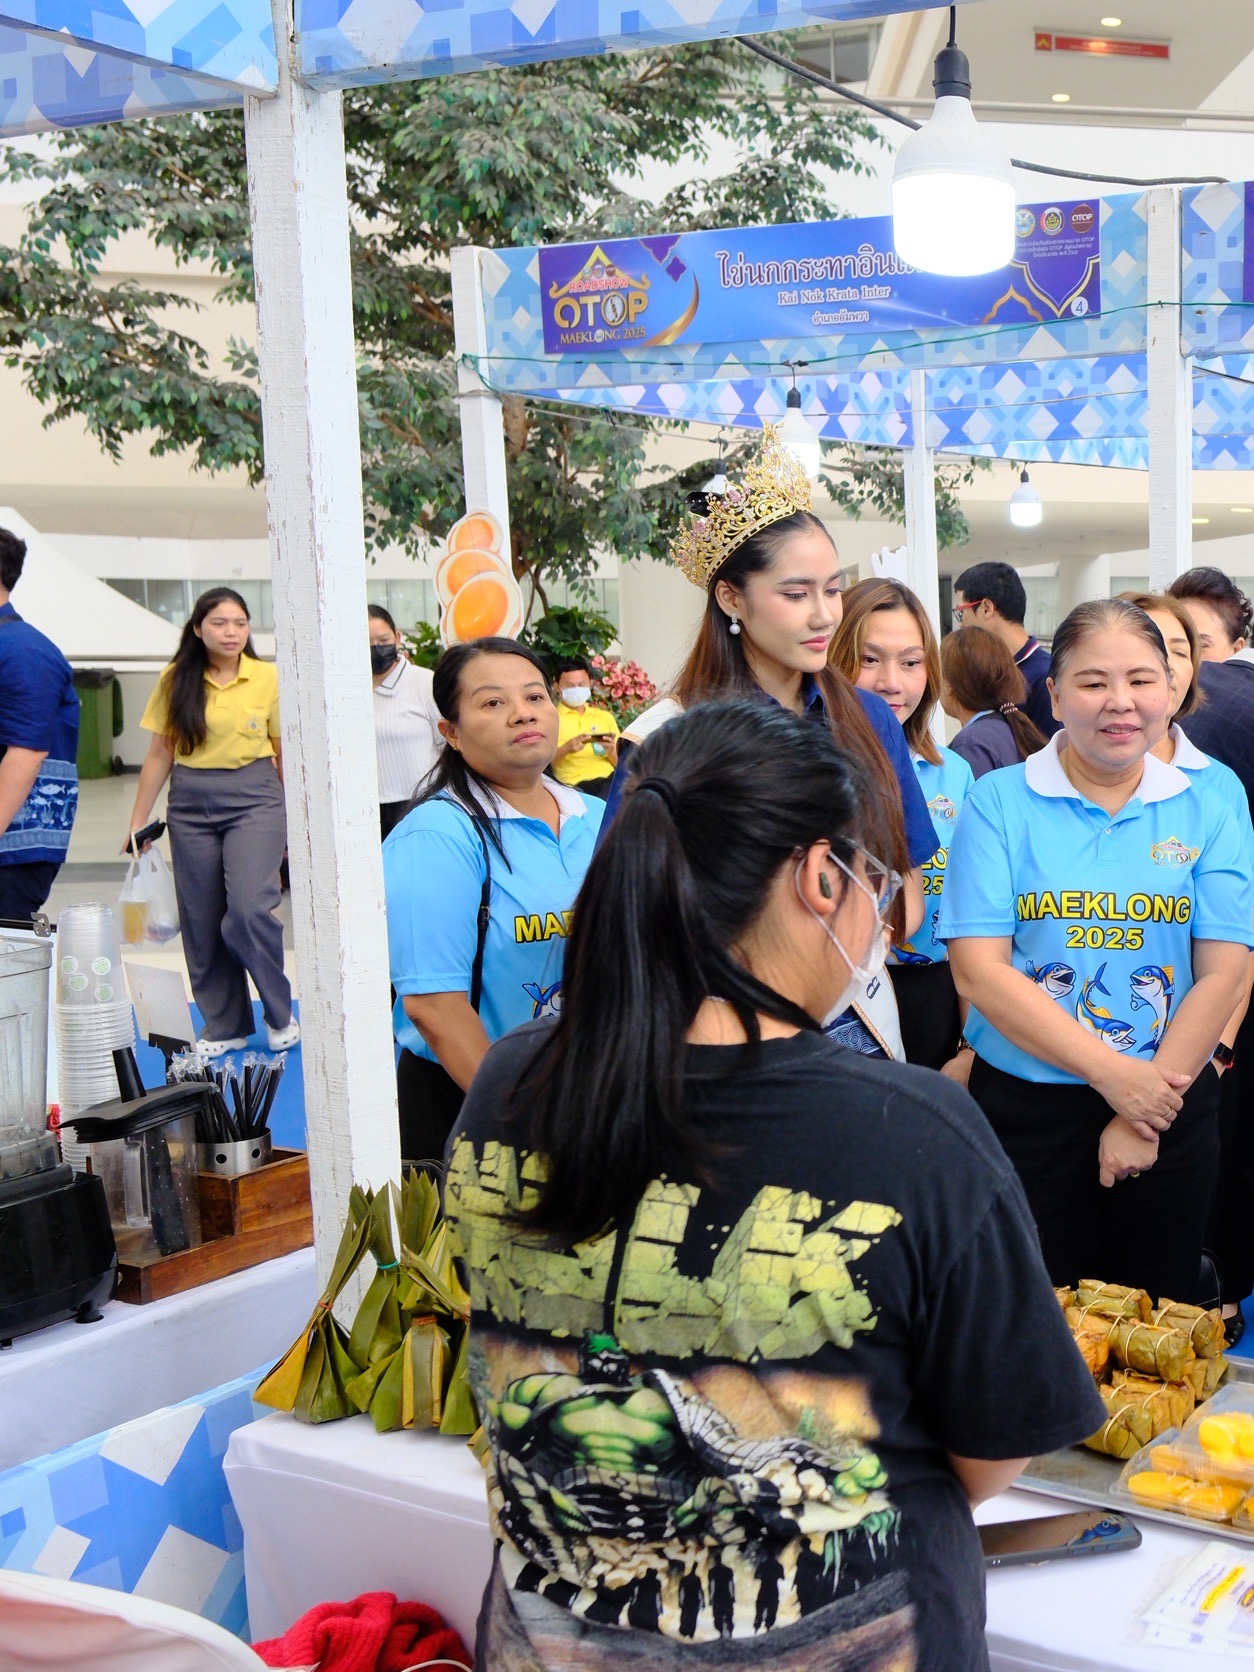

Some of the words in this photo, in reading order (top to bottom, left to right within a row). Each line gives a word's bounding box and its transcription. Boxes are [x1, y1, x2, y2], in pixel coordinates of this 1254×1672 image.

[1072, 213, 1093, 222] OTOP
[569, 276, 630, 293] ROADSHOW
[778, 291, 799, 305] Kai
[801, 290, 824, 304] Nok
[827, 288, 859, 303] Krata
[861, 286, 891, 300] Inter
[554, 290, 649, 329] OTOP
[1075, 300, 1085, 313] 4
[812, 310, 870, 326] อำเภออัมพวา
[560, 329, 621, 345] MAEKLONG
[623, 326, 647, 340] 2025
[1017, 891, 1191, 924] MAEKLONG
[1066, 925, 1144, 951] 2025
